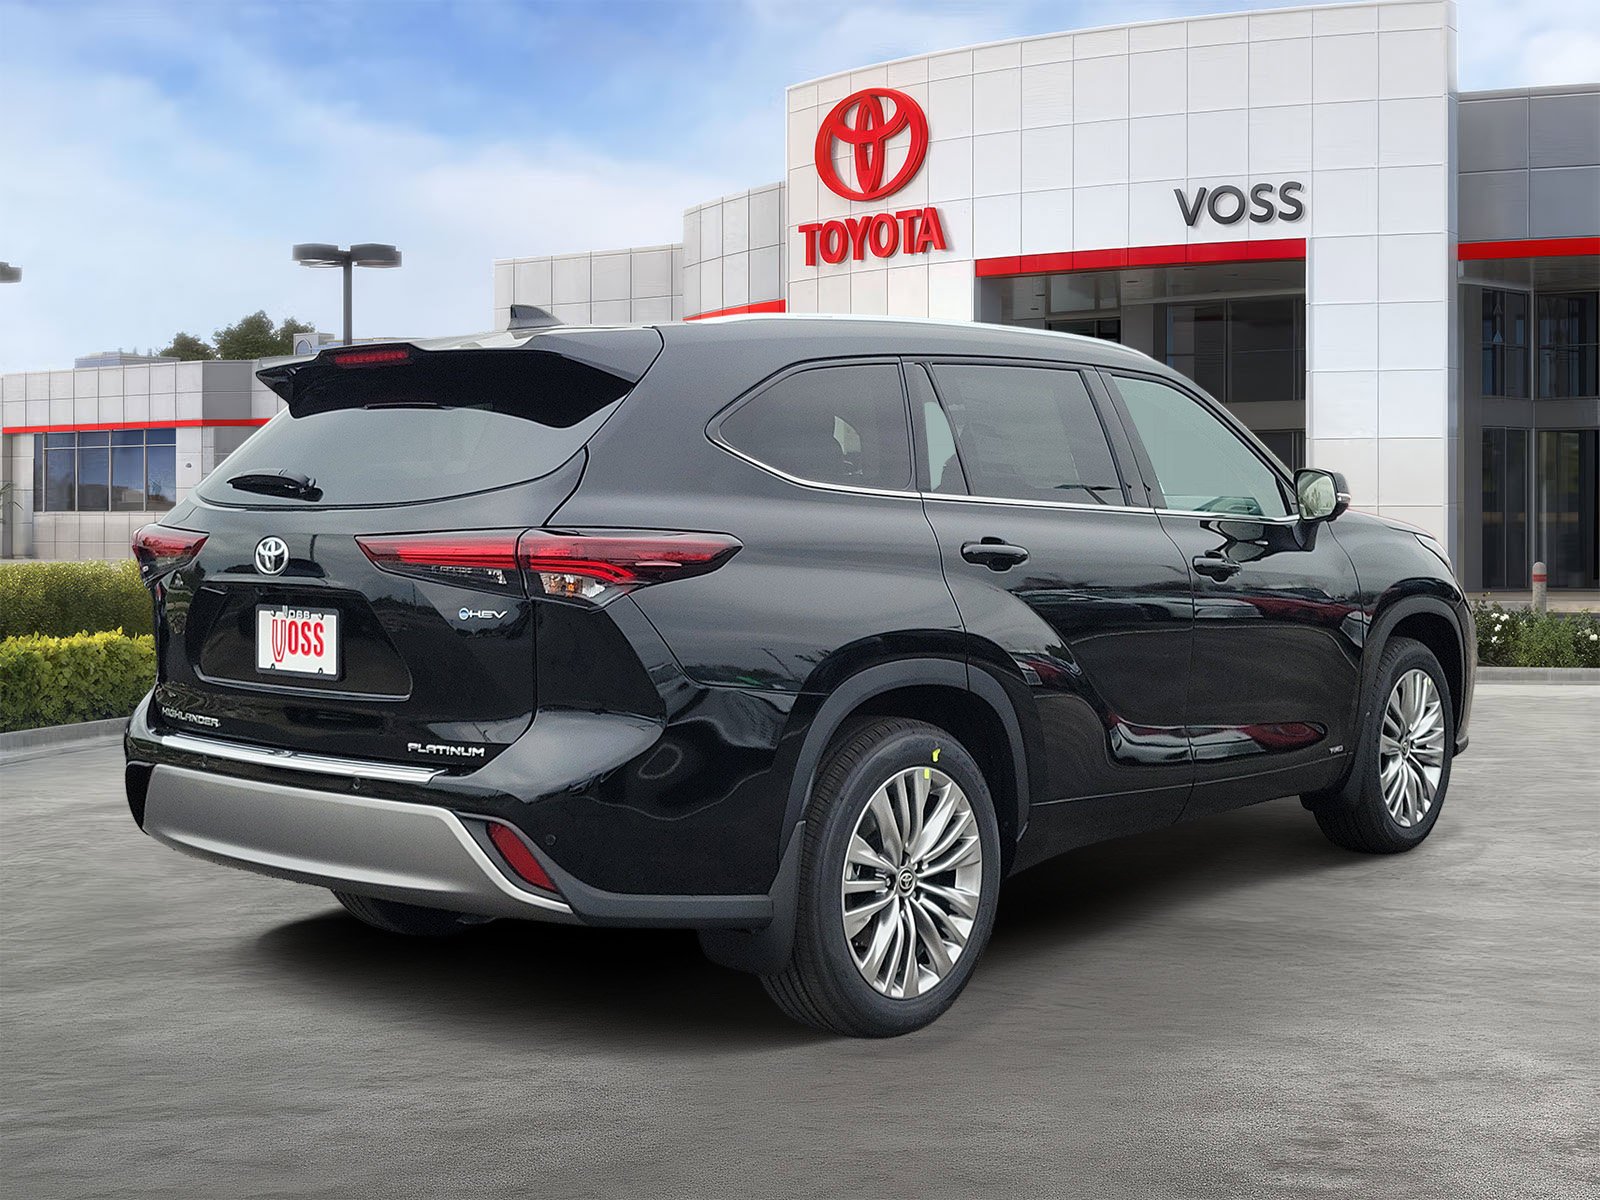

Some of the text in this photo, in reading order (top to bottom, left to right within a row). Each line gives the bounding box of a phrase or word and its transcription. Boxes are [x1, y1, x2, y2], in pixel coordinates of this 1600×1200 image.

[1173, 181, 1303, 226] VOSS
[798, 207, 946, 266] TOYOTA
[272, 619, 324, 662] VOSS
[162, 706, 219, 728] HIGHLANDER
[407, 742, 485, 757] PLATINUM
